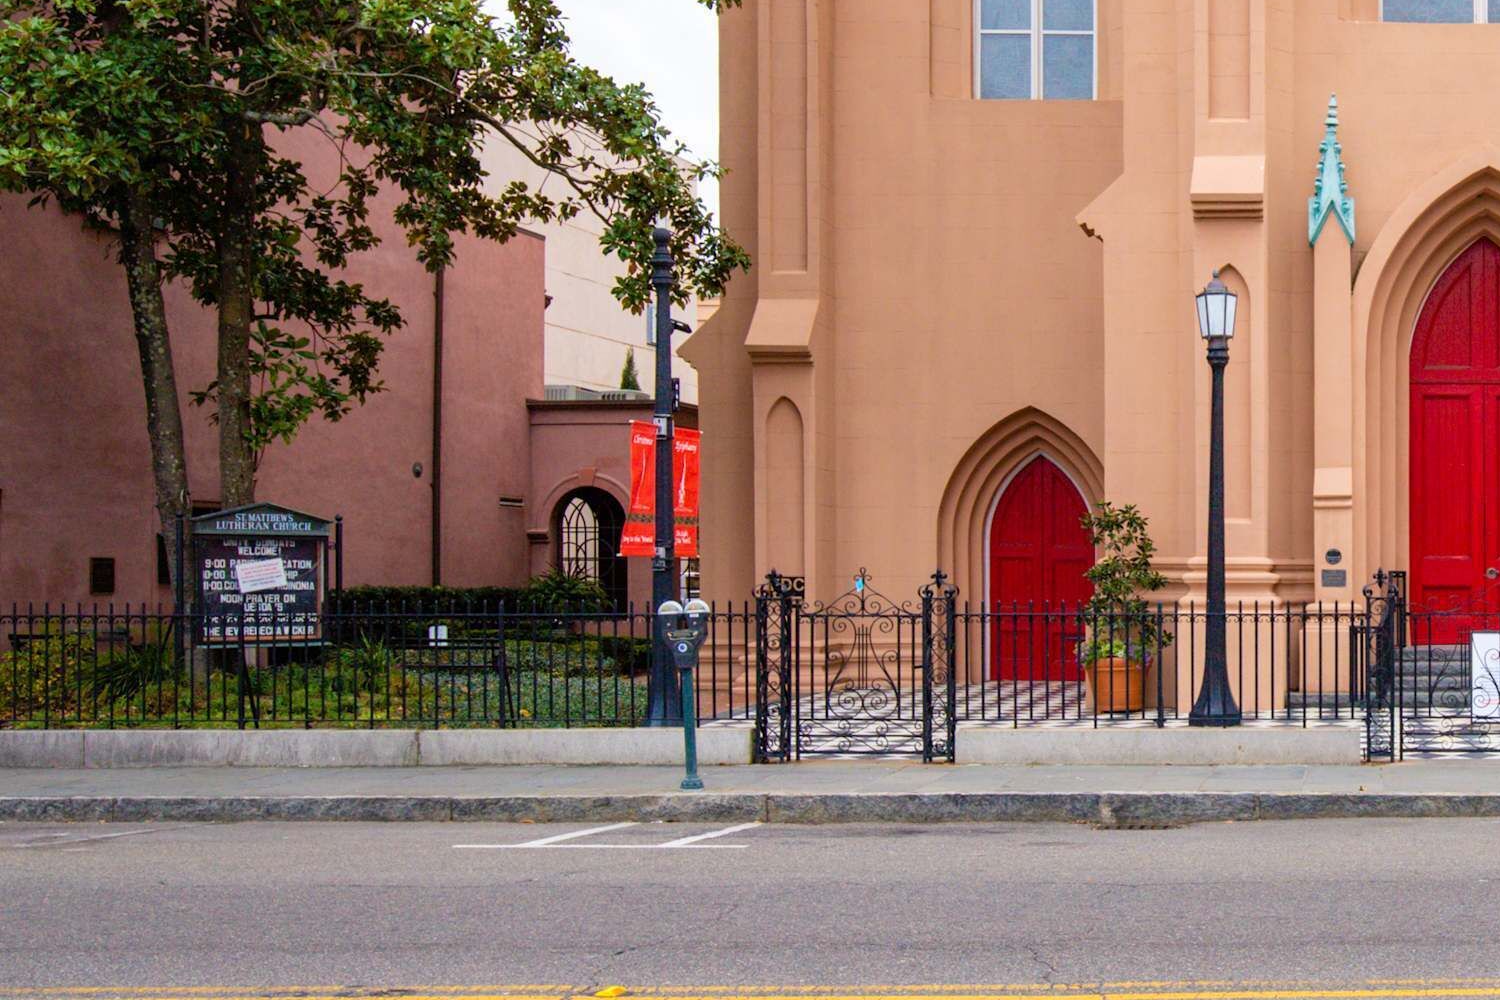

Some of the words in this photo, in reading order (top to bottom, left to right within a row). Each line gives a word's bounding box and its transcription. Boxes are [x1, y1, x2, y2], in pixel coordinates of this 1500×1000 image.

[217, 522, 269, 531] LUTHERAN
[273, 523, 312, 532] CHURCH
[221, 594, 242, 604] NOON
[246, 595, 281, 604] PRAYER
[284, 595, 297, 604] ON
